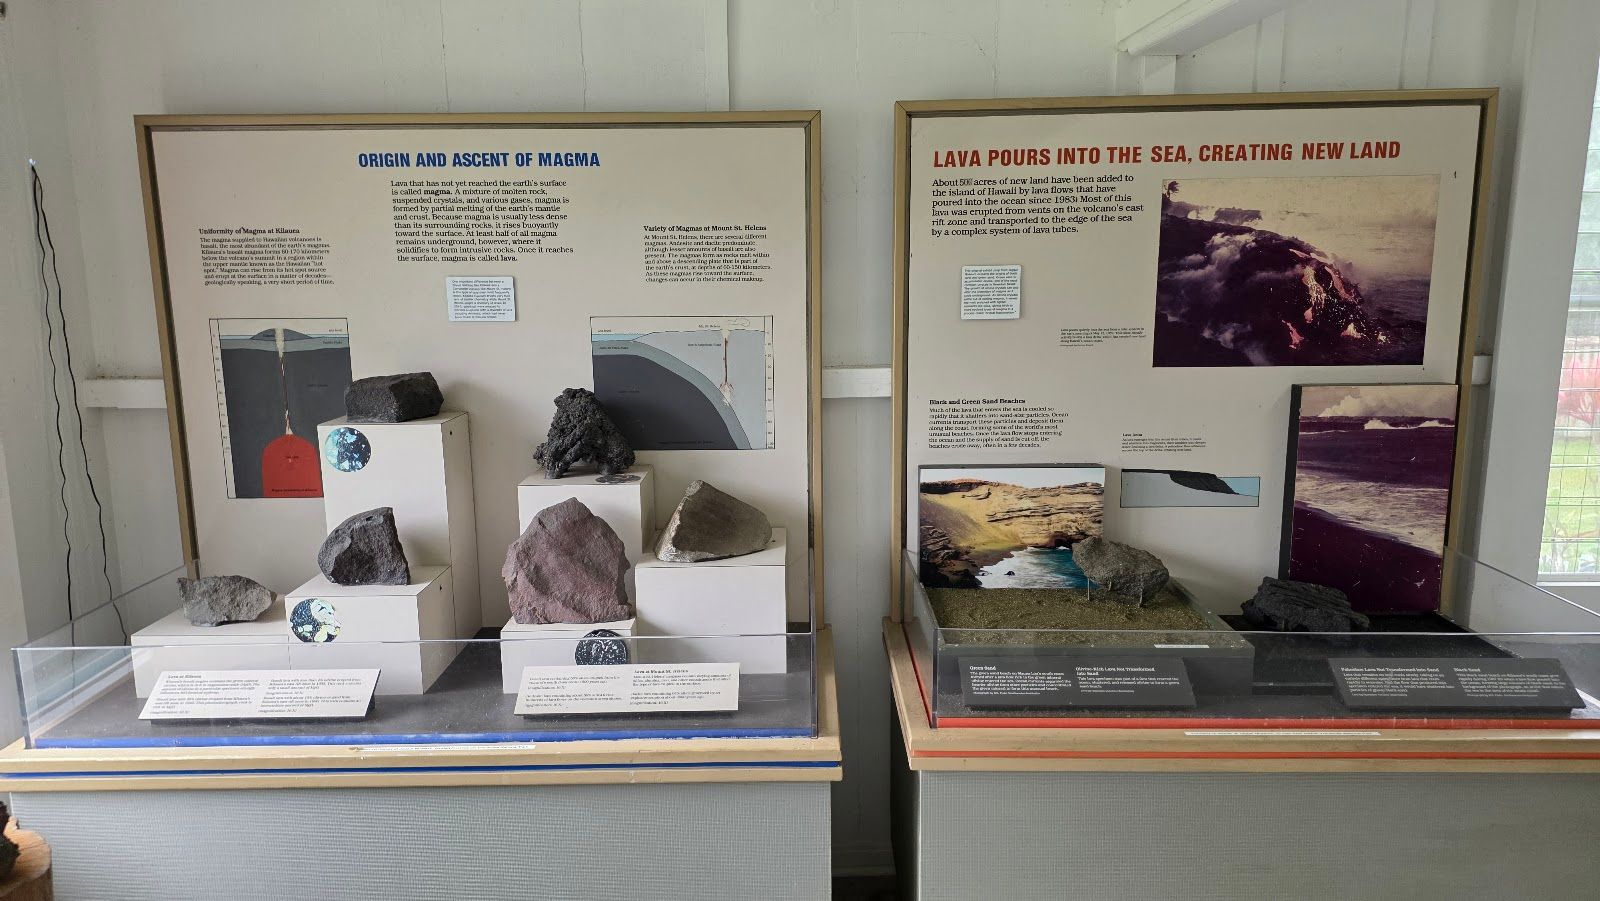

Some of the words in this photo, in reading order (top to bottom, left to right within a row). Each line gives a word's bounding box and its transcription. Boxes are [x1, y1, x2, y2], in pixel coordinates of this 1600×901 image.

[358, 153, 411, 168] ORIGIN
[416, 152, 447, 168] AND
[452, 152, 509, 167] ASCENT
[515, 152, 533, 167] OF
[538, 152, 600, 167] MAGMA
[934, 150, 982, 168] LAVA
[988, 148, 1050, 167] POURS
[1056, 146, 1101, 165] INTO
[1106, 146, 1143, 164] THE
[1150, 145, 1192, 165] SEA,
[1198, 143, 1293, 162] CREATING
[1301, 142, 1345, 160] NEW
[1350, 141, 1400, 159] LAND
[455, 180, 466, 188] yet
[999, 177, 1008, 185] of
[1051, 176, 1071, 184] have
[1097, 175, 1123, 183] added
[932, 189, 947, 197] the
[948, 188, 975, 196] island
[977, 188, 986, 196] of
[988, 187, 1017, 196] Hawaii
[1019, 187, 1030, 196] by
[1051, 186, 1074, 194] flows
[1096, 185, 1116, 193] have
[392, 197, 432, 205] suspended
[433, 197, 465, 206] crystals,
[932, 199, 962, 208] poured
[965, 198, 982, 206] into
[1114, 194, 1132, 202] this
[420, 205, 429, 214] by
[431, 205, 455, 213] partial
[456, 205, 485, 214] melting
[932, 209, 949, 217] lava
[970, 208, 1003, 217] erupted
[1005, 207, 1026, 215] from
[1027, 206, 1051, 214] vents
[1083, 204, 1124, 213] volcano's
[1126, 204, 1144, 212] east
[424, 222, 470, 230] surrounding
[988, 217, 1039, 226] transported
[1052, 216, 1066, 224] the
[1068, 215, 1088, 224] edge
[1101, 214, 1116, 222] the
[932, 229, 942, 238] by
[951, 228, 988, 237] complex
[989, 227, 1020, 237] system
[1022, 226, 1031, 234] of
[1032, 226, 1050, 234] lava
[1052, 225, 1079, 233] tubes.
